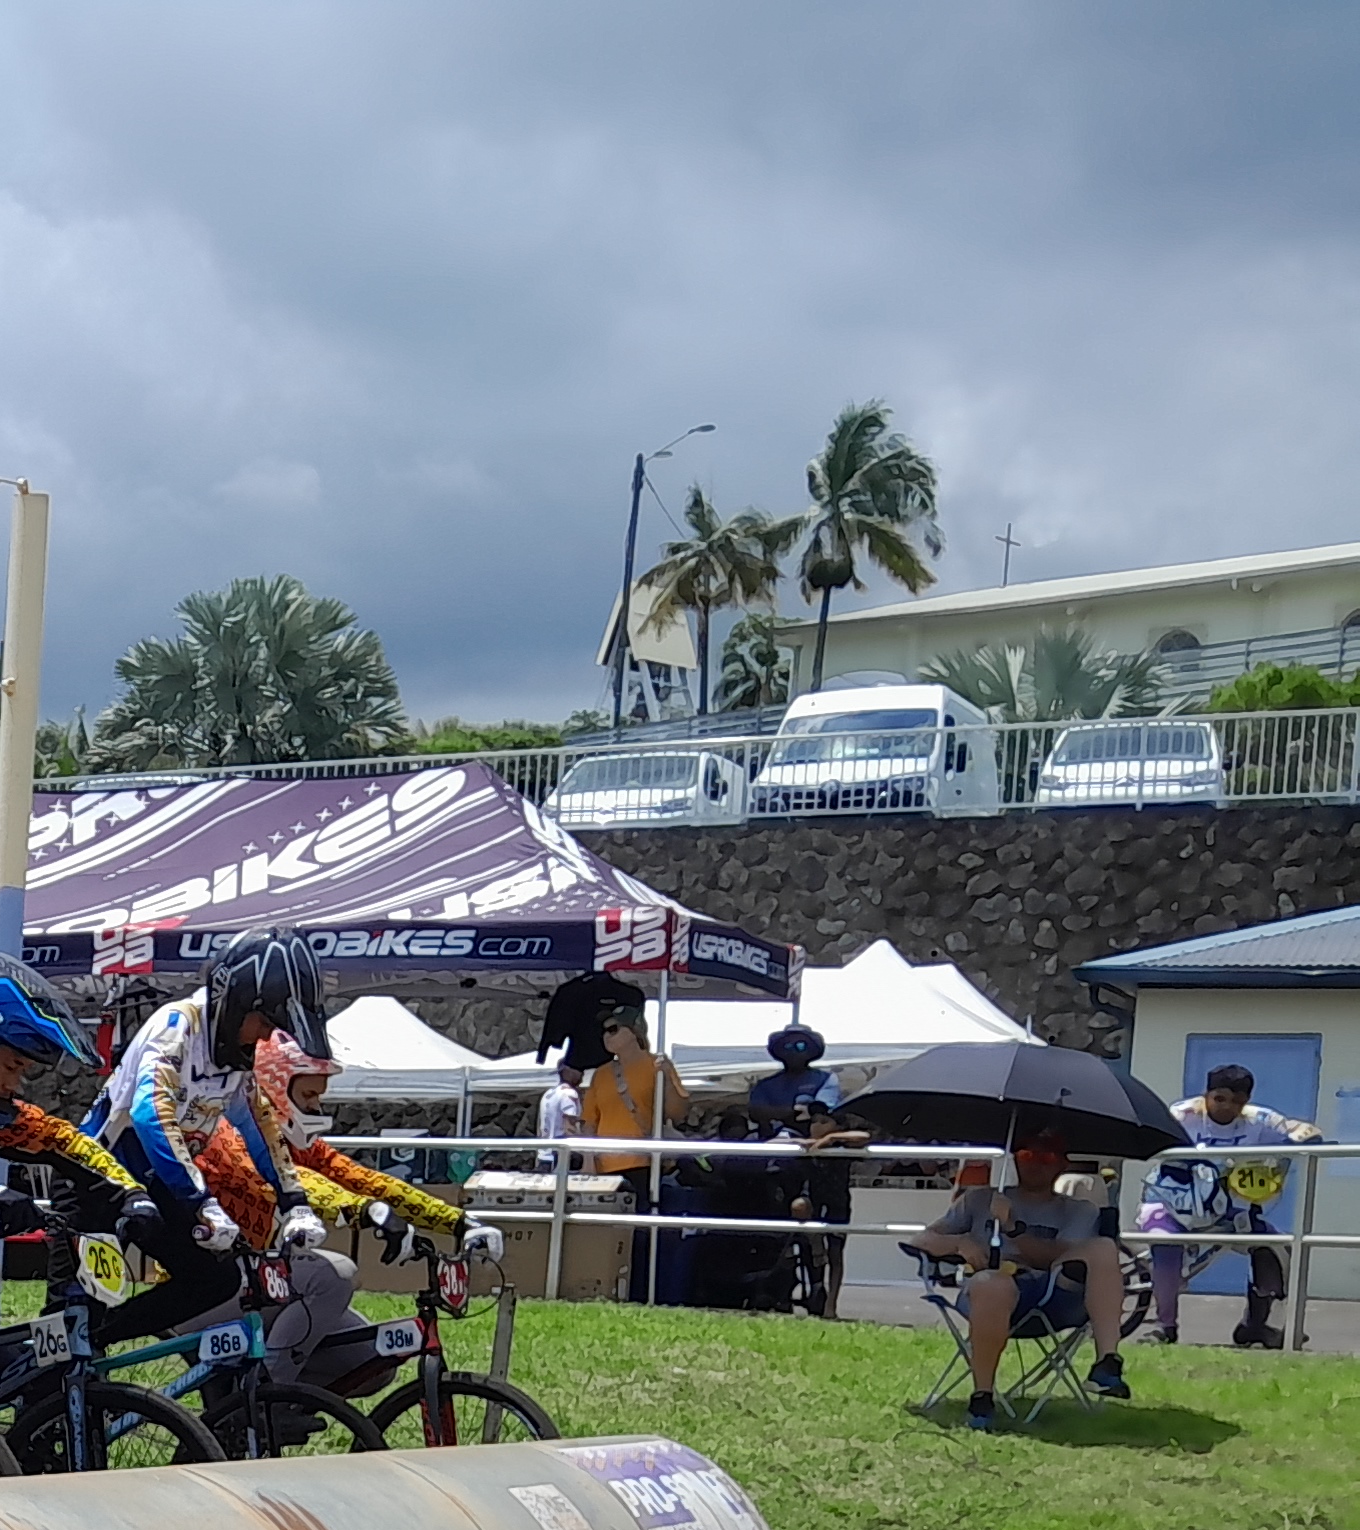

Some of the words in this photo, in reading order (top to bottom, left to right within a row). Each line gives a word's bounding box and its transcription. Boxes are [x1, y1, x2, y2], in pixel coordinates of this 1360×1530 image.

[180, 930, 477, 958] USOBIKES
[88, 1245, 121, 1279] 26G
[35, 1324, 67, 1359] 26G
[210, 1333, 241, 1355] 86B
